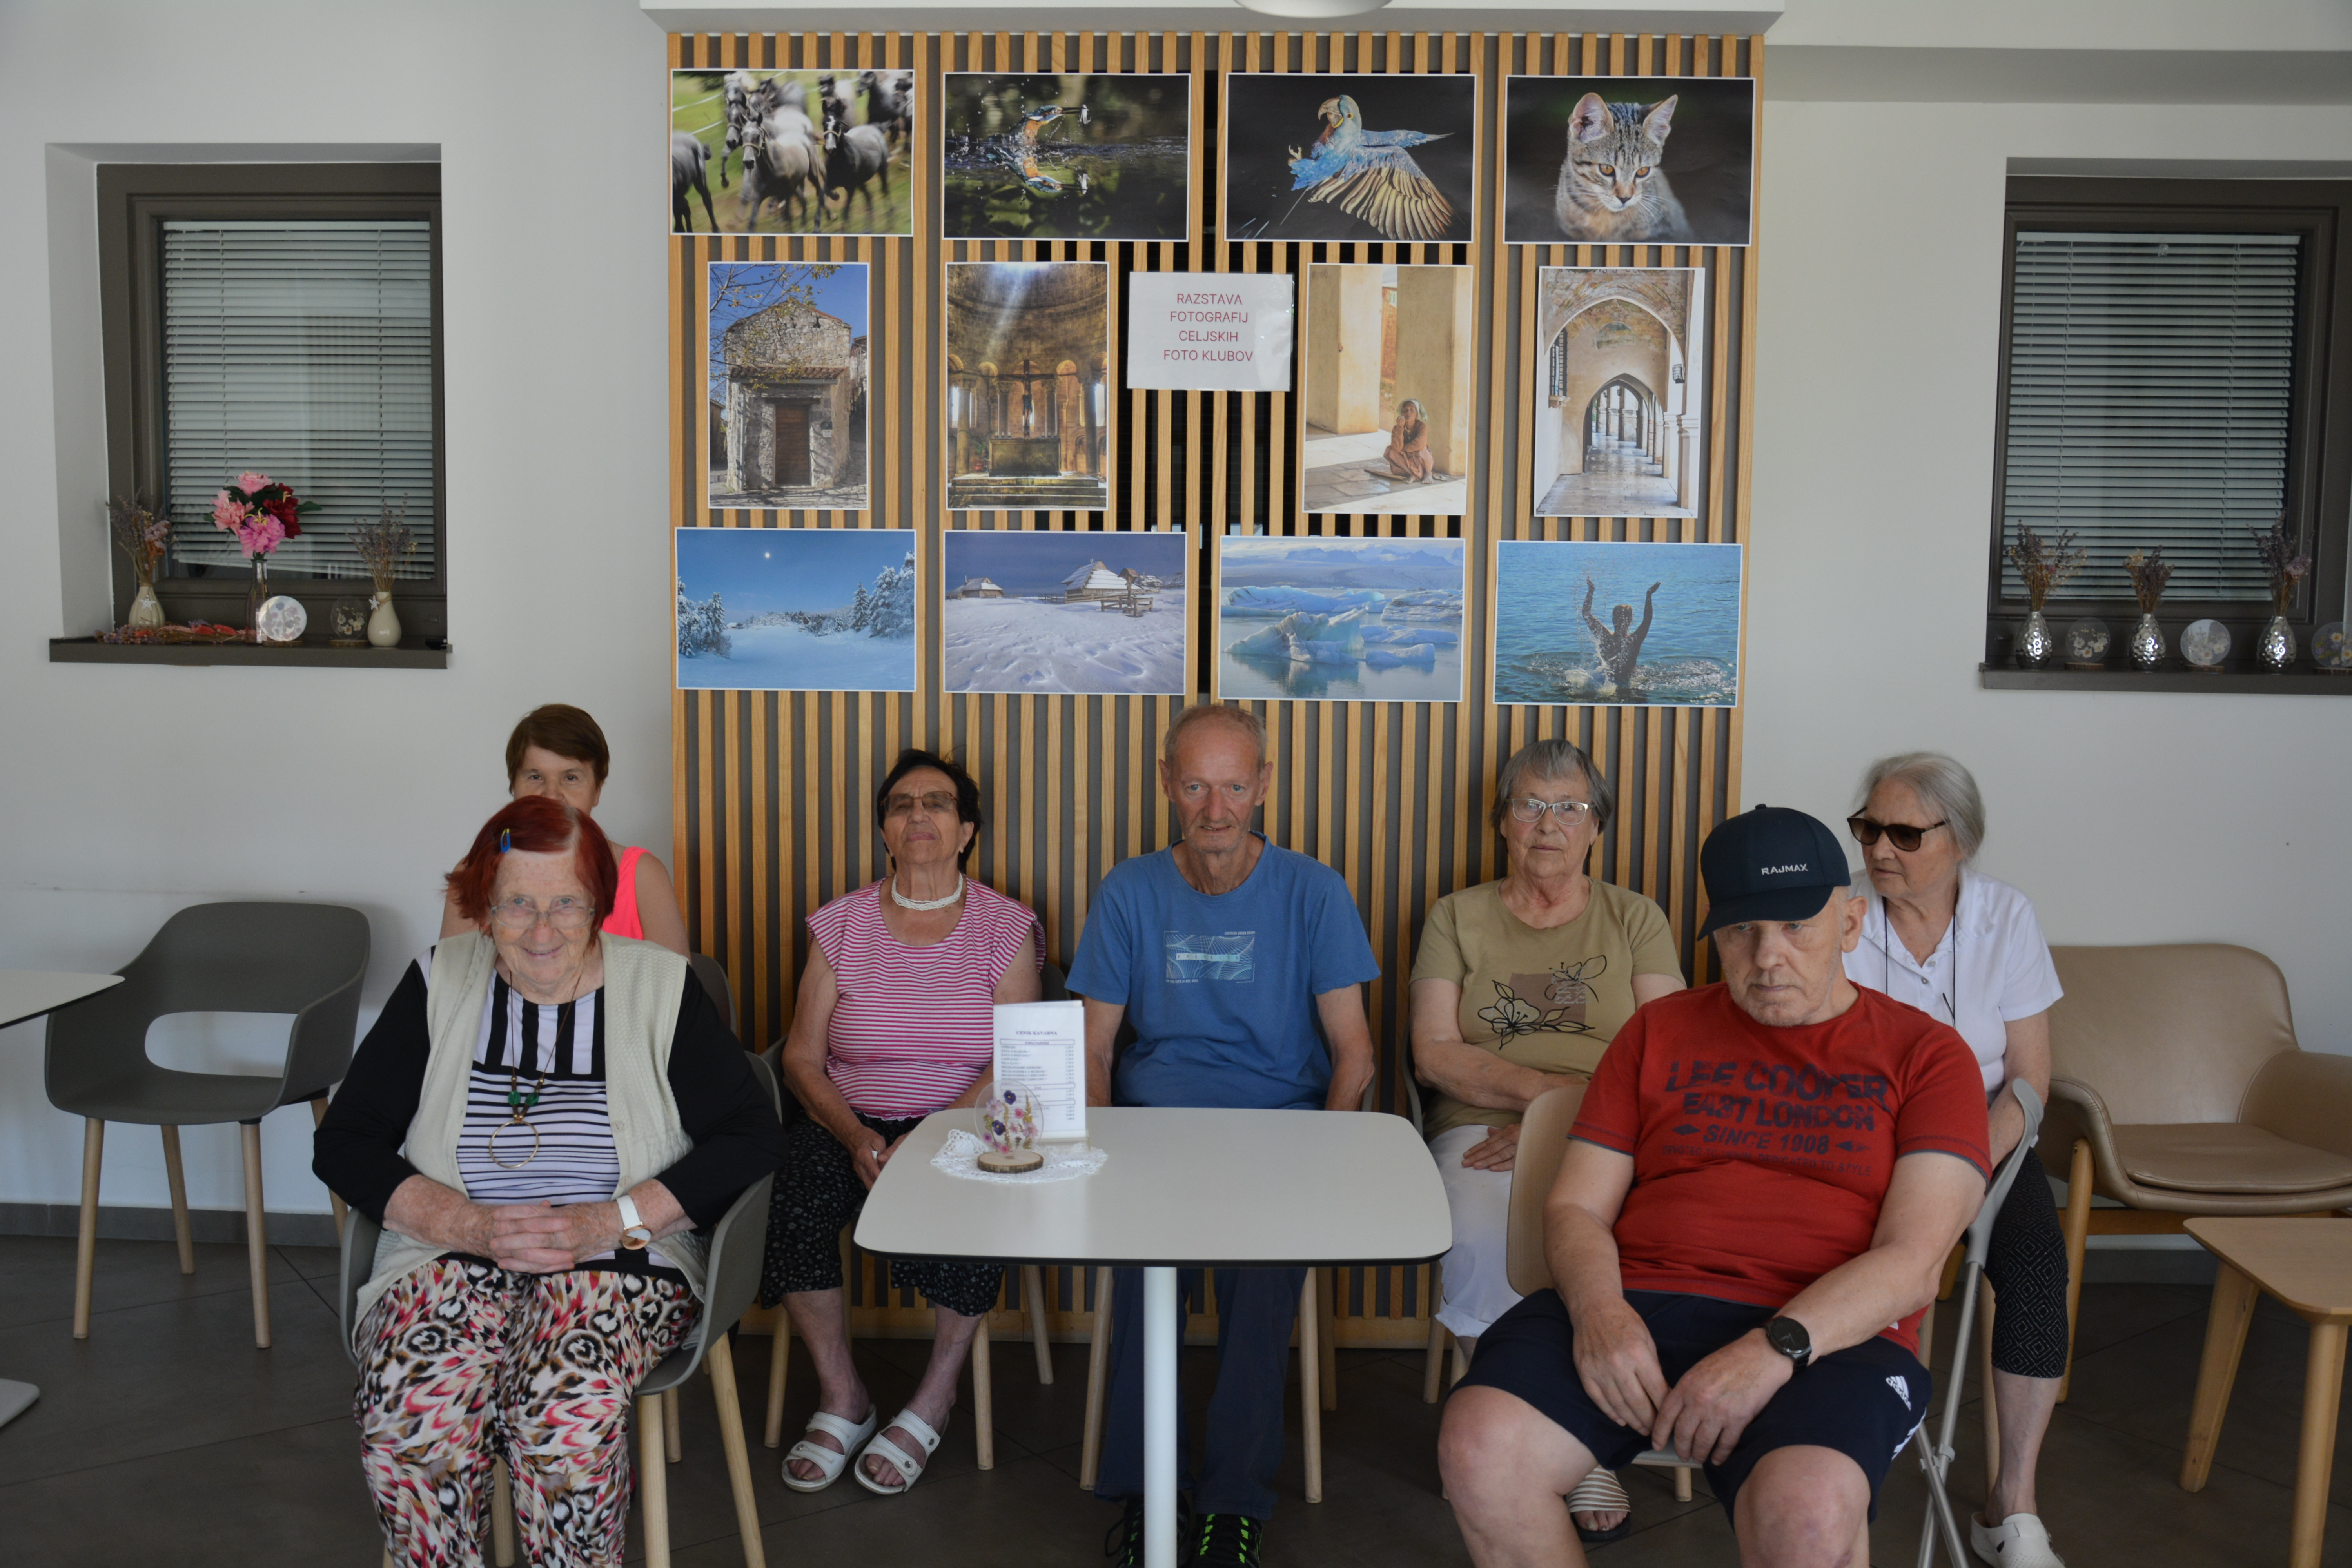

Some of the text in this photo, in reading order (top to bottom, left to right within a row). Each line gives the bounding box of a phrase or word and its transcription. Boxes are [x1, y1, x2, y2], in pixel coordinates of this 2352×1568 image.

[1176, 293, 1242, 305] RAZSTAVA
[1170, 311, 1248, 323] FOTOGRAFIJ
[1178, 330, 1238, 342] CELJSKIH
[1164, 350, 1253, 361] FOTO KLUBOV
[1761, 863, 1808, 875] RAJMAX
[1664, 1060, 1891, 1113] LEE COOPER
[1683, 1093, 1875, 1131] EAST LONDON
[1703, 1124, 1830, 1154] SINCE 1908
[1662, 1145, 1702, 1157] DEVOTED
[1758, 1152, 1817, 1168] DEDICATED
[1821, 1160, 1835, 1171] TO
[1838, 1162, 1872, 1176] STYLE
